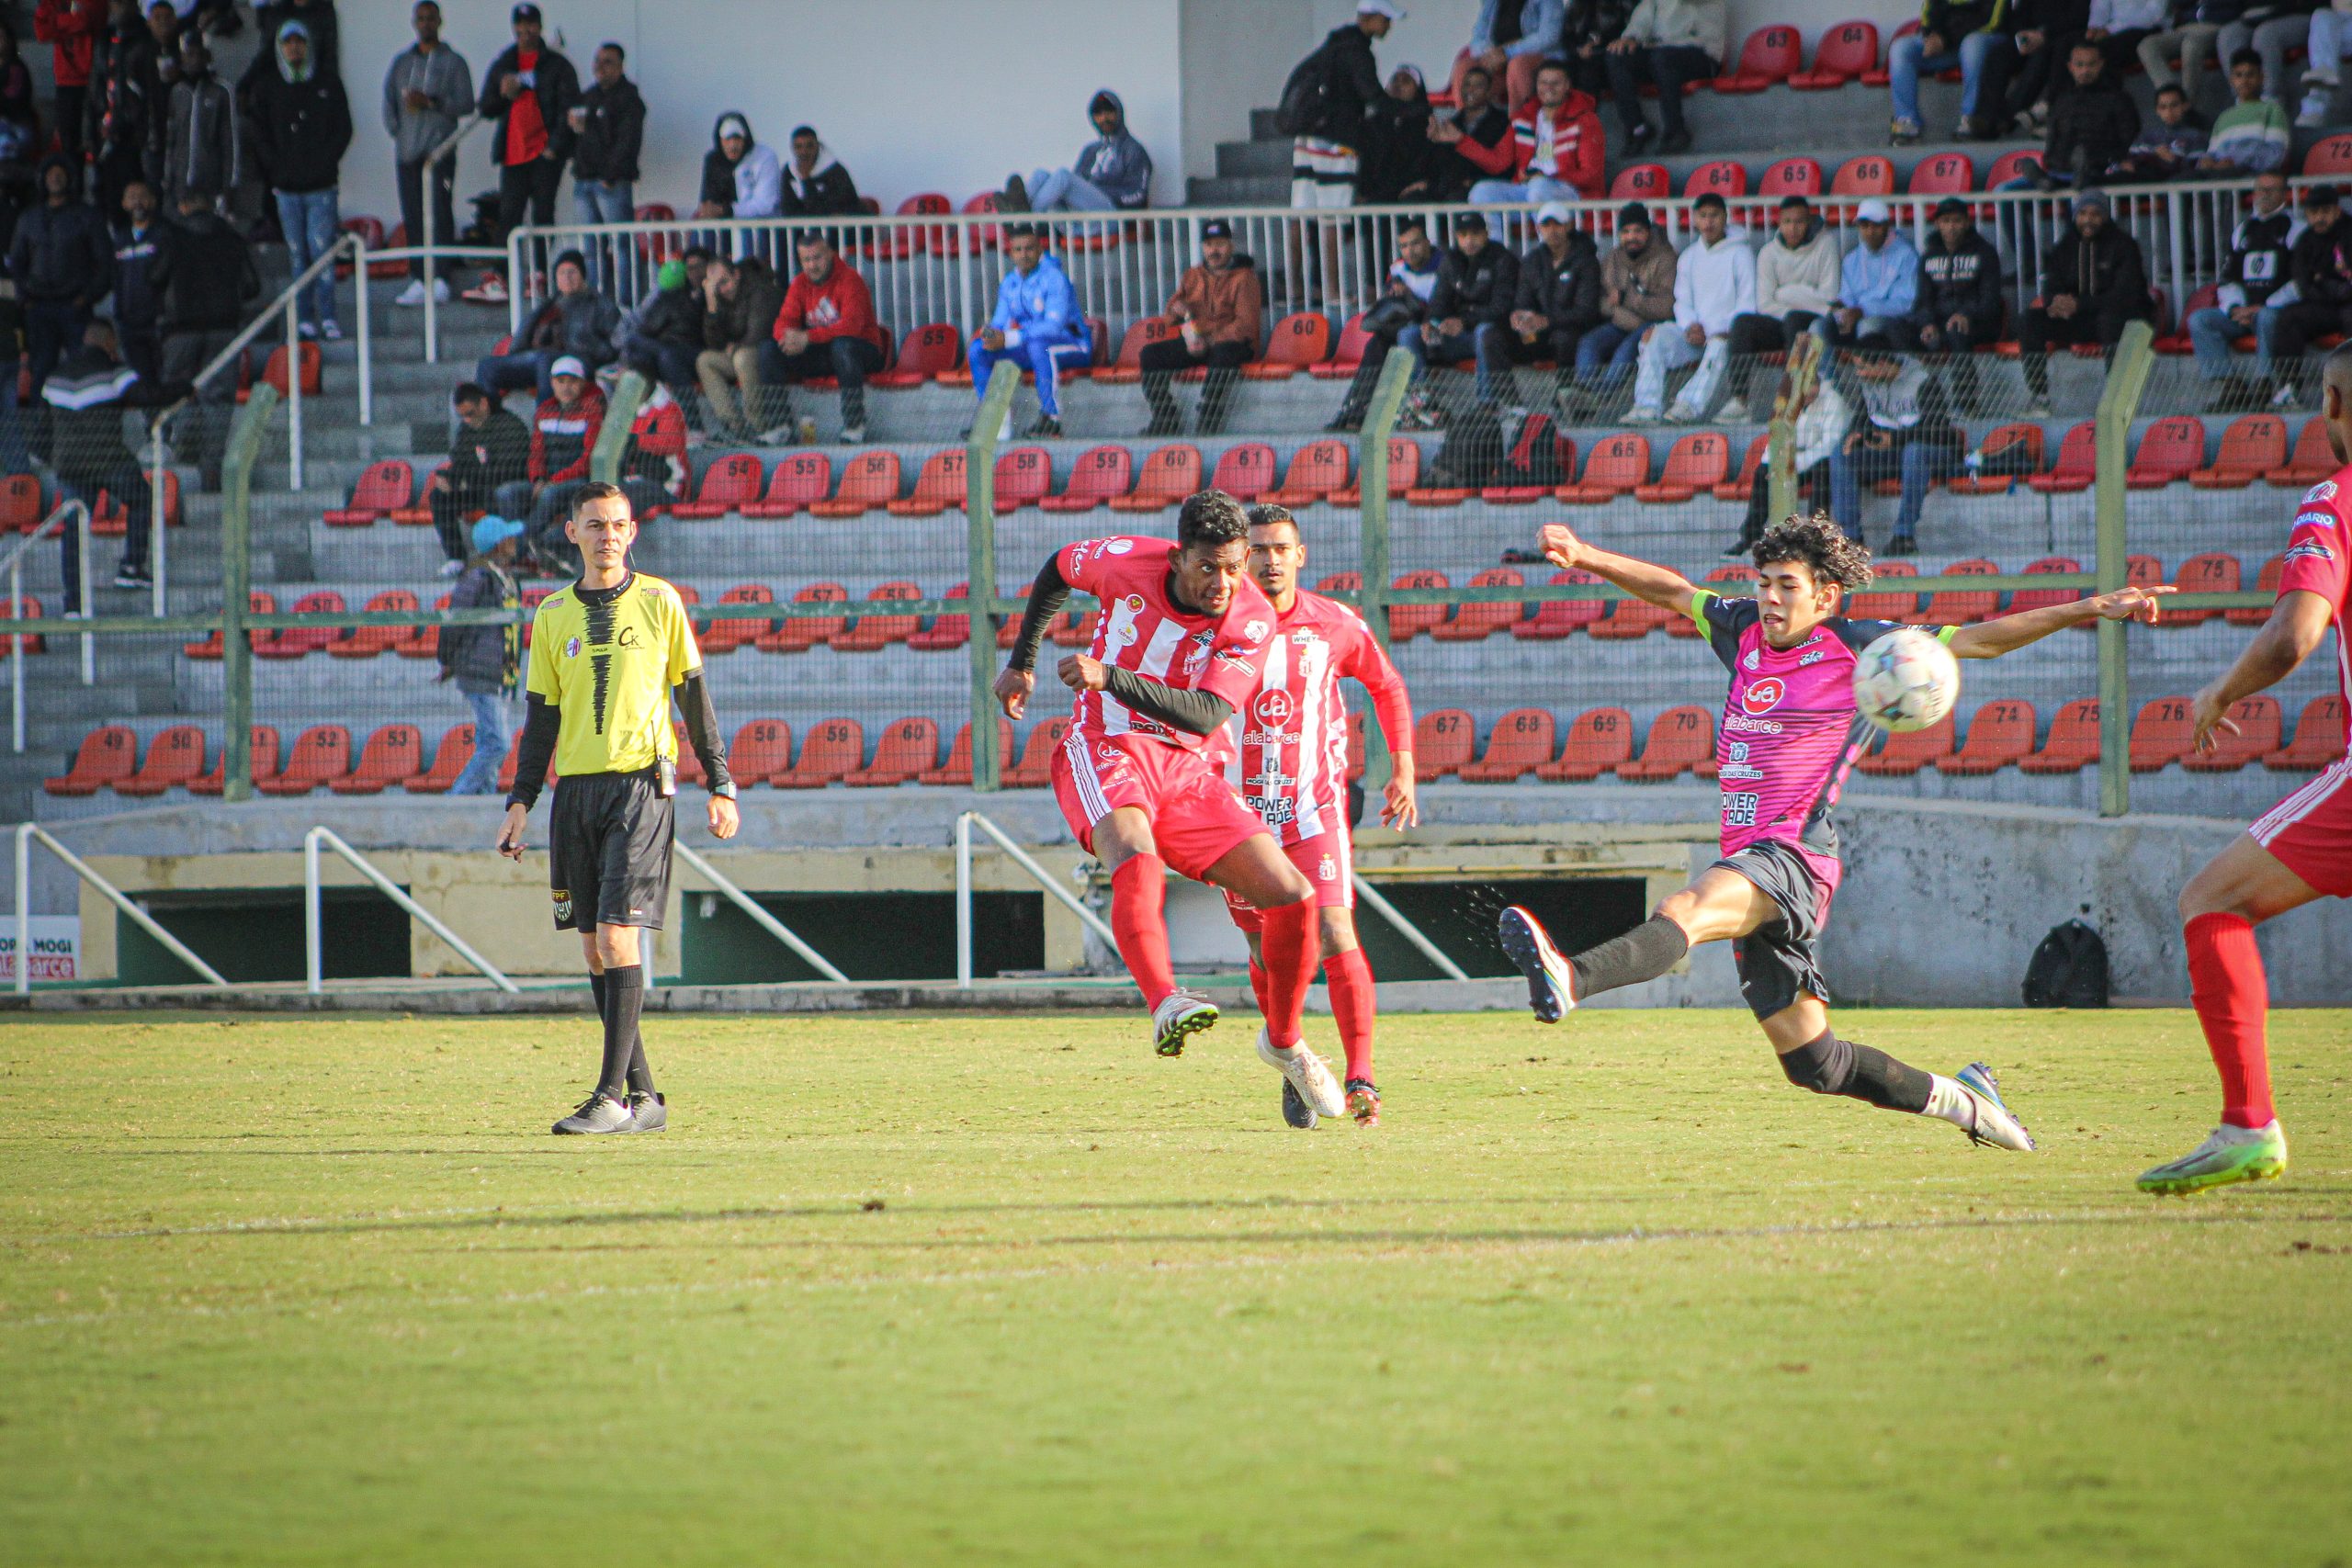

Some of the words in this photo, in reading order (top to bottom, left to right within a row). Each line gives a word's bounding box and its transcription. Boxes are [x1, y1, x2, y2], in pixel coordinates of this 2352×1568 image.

[1767, 32, 1788, 48] 63
[1843, 28, 1862, 42] 64
[1783, 166, 1806, 182] 65
[1857, 164, 1879, 180] 66
[1935, 161, 1957, 176] 67
[1634, 171, 1657, 187] 63
[1710, 168, 1731, 186] 64
[1294, 319, 1316, 334] 60
[2165, 423, 2188, 440] 73
[2249, 423, 2271, 438] 74
[1692, 439, 1713, 455] 67
[944, 456, 963, 472] 57
[1018, 454, 1037, 469] 58
[1097, 453, 1118, 469] 59
[1166, 451, 1187, 468] 60
[1239, 450, 1261, 467] 61
[1314, 448, 1334, 464] 62
[729, 460, 749, 476] 54
[796, 459, 816, 475] 55
[867, 458, 886, 473] 56
[381, 467, 401, 482] 49
[2204, 559, 2224, 577] 75
[1996, 706, 2018, 723] 74
[2079, 705, 2100, 721] 75
[2163, 705, 2185, 722] 76
[2243, 703, 2265, 721] 77
[1436, 716, 1459, 733] 67
[1516, 716, 1539, 733] 68
[1593, 716, 1617, 732] 69
[1677, 713, 1698, 731] 70
[104, 731, 124, 750] 49
[172, 731, 191, 750] 50
[316, 730, 337, 749] 52
[387, 730, 407, 748] 53
[755, 726, 776, 742] 58
[828, 726, 848, 742] 59
[903, 725, 923, 742] 60
[1736, 771, 1761, 779] CRUZES
[1246, 795, 1293, 812] POWER
[1722, 793, 1758, 809] OWER
[33, 938, 72, 953] MOGI
